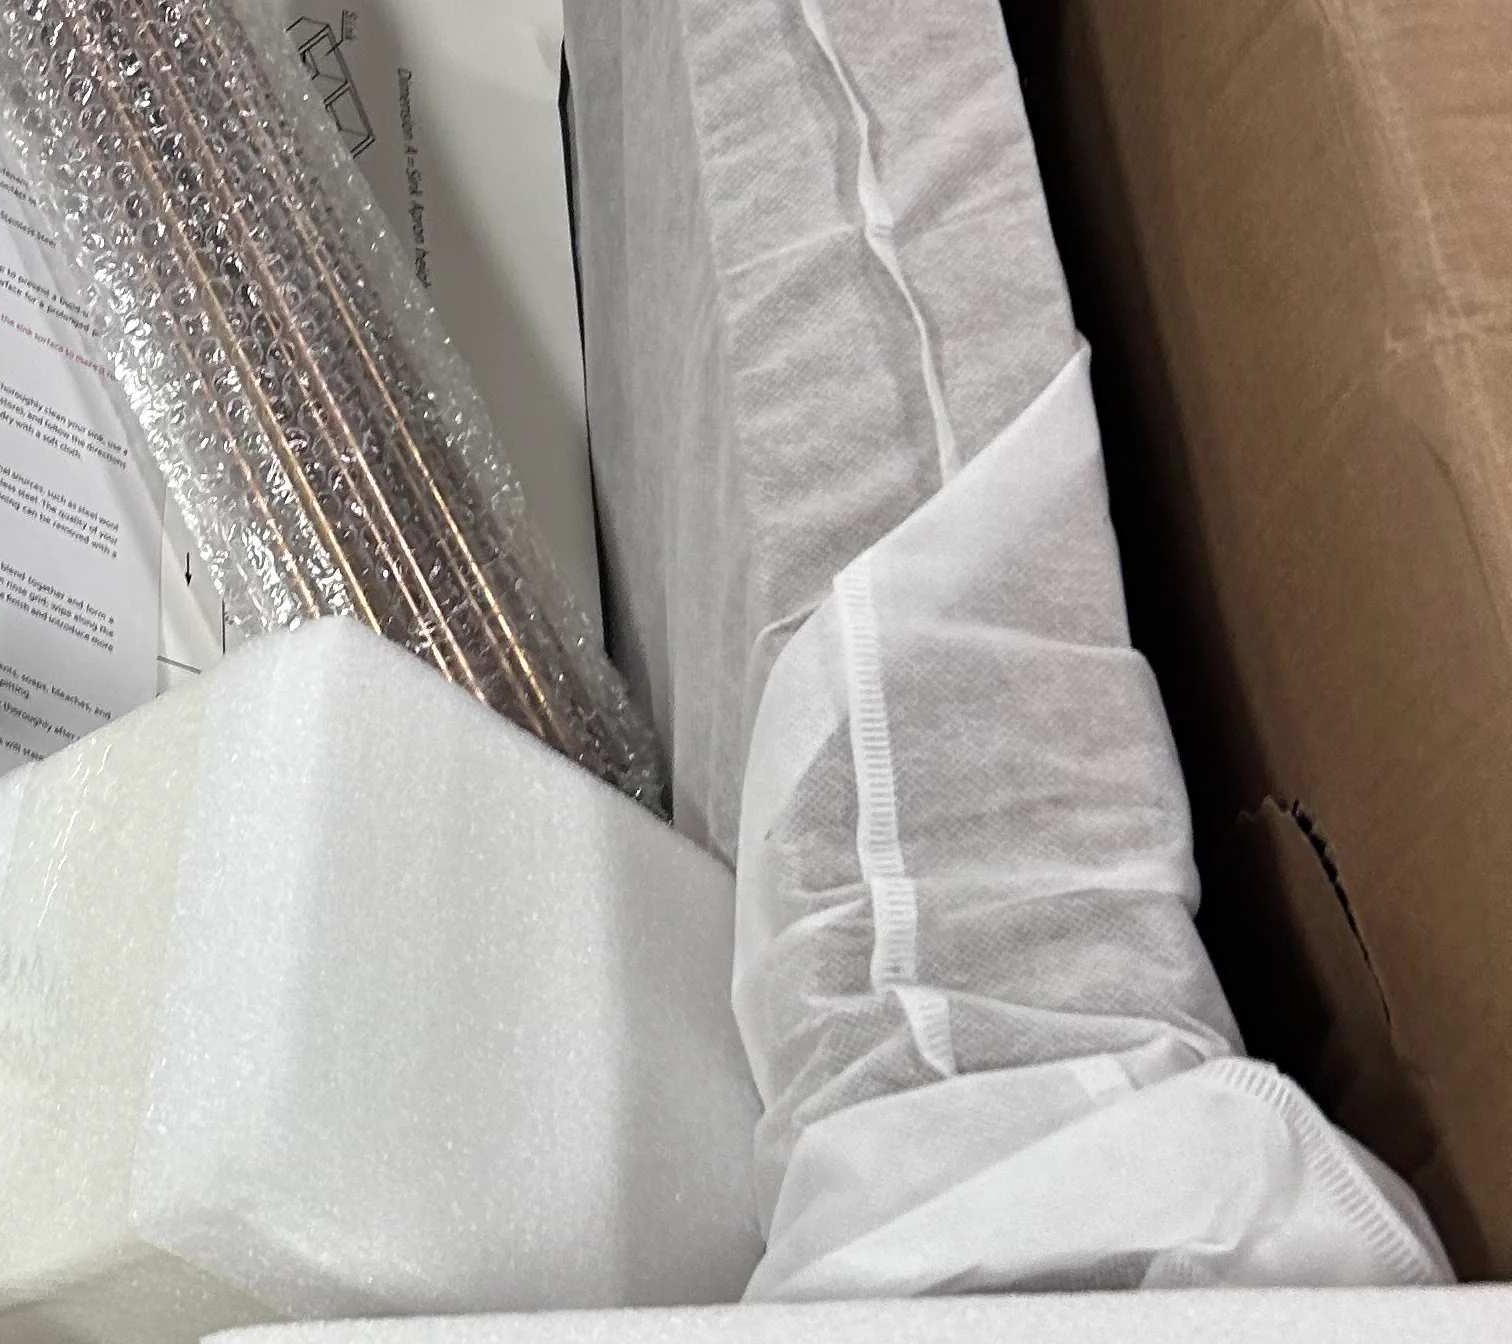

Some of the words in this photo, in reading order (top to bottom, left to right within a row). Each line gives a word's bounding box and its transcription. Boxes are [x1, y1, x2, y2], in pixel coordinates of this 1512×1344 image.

[5, 267, 17, 279] to
[14, 420, 35, 435] with
[34, 431, 42, 439] a
[41, 434, 59, 448] soft
[42, 407, 67, 424] clean
[64, 419, 86, 434] your
[105, 440, 122, 452] use
[26, 575, 65, 600] together
[66, 596, 85, 609] and
[84, 603, 107, 620] form
